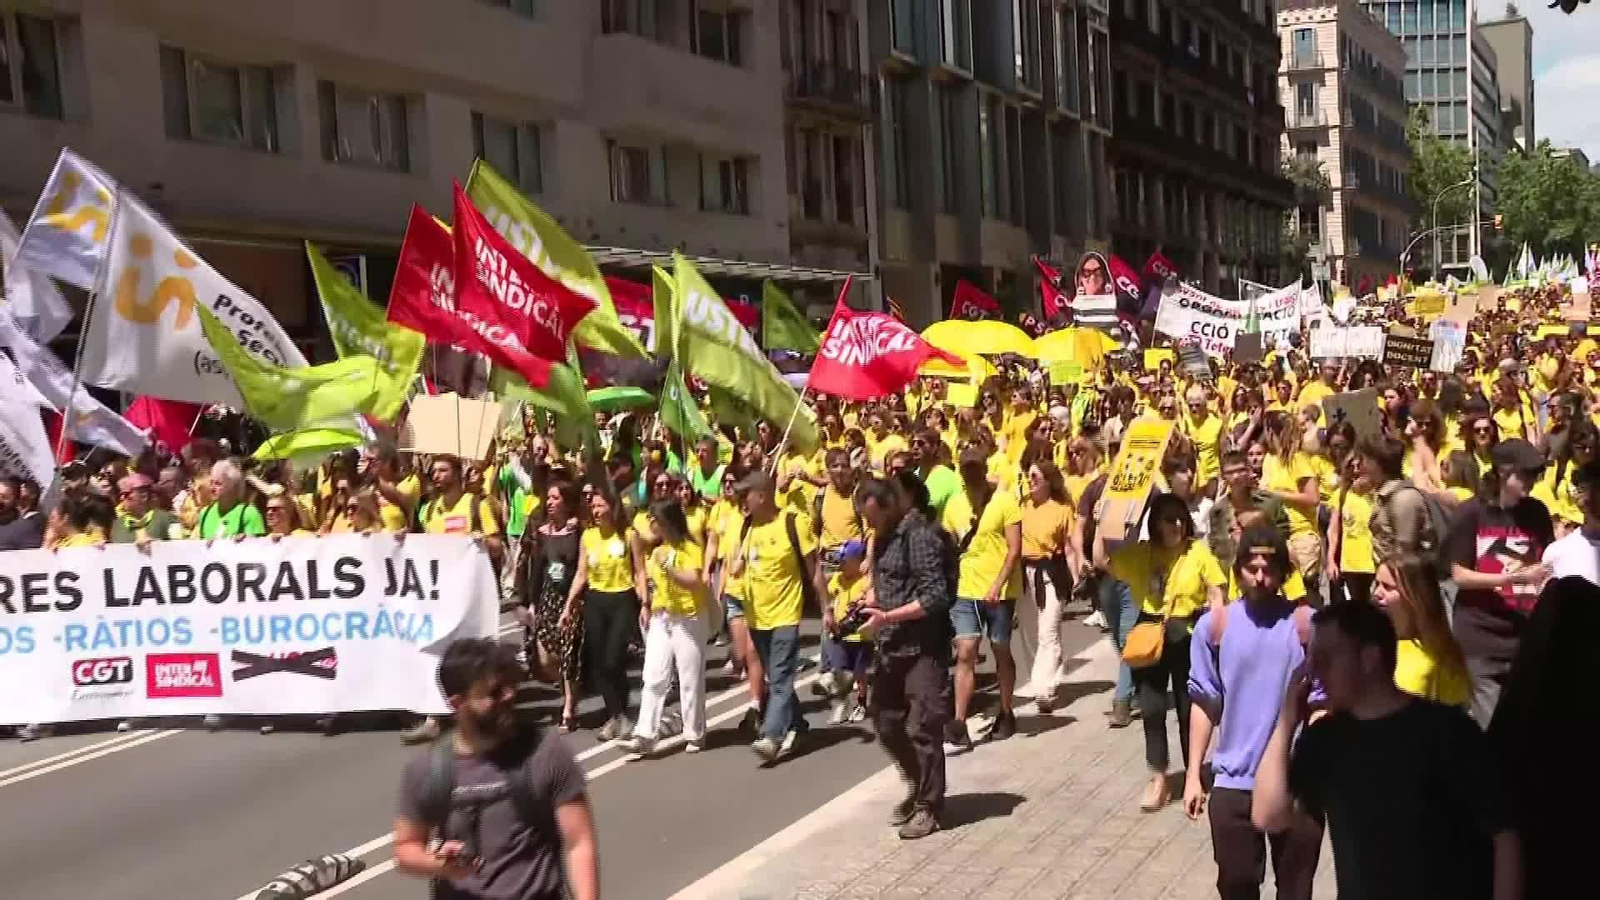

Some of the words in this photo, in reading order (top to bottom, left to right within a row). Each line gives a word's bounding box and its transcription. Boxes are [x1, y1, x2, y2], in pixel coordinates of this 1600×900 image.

[103, 555, 365, 608] LABORALS
[383, 557, 440, 601] JA!
[76, 659, 131, 684] CGT
